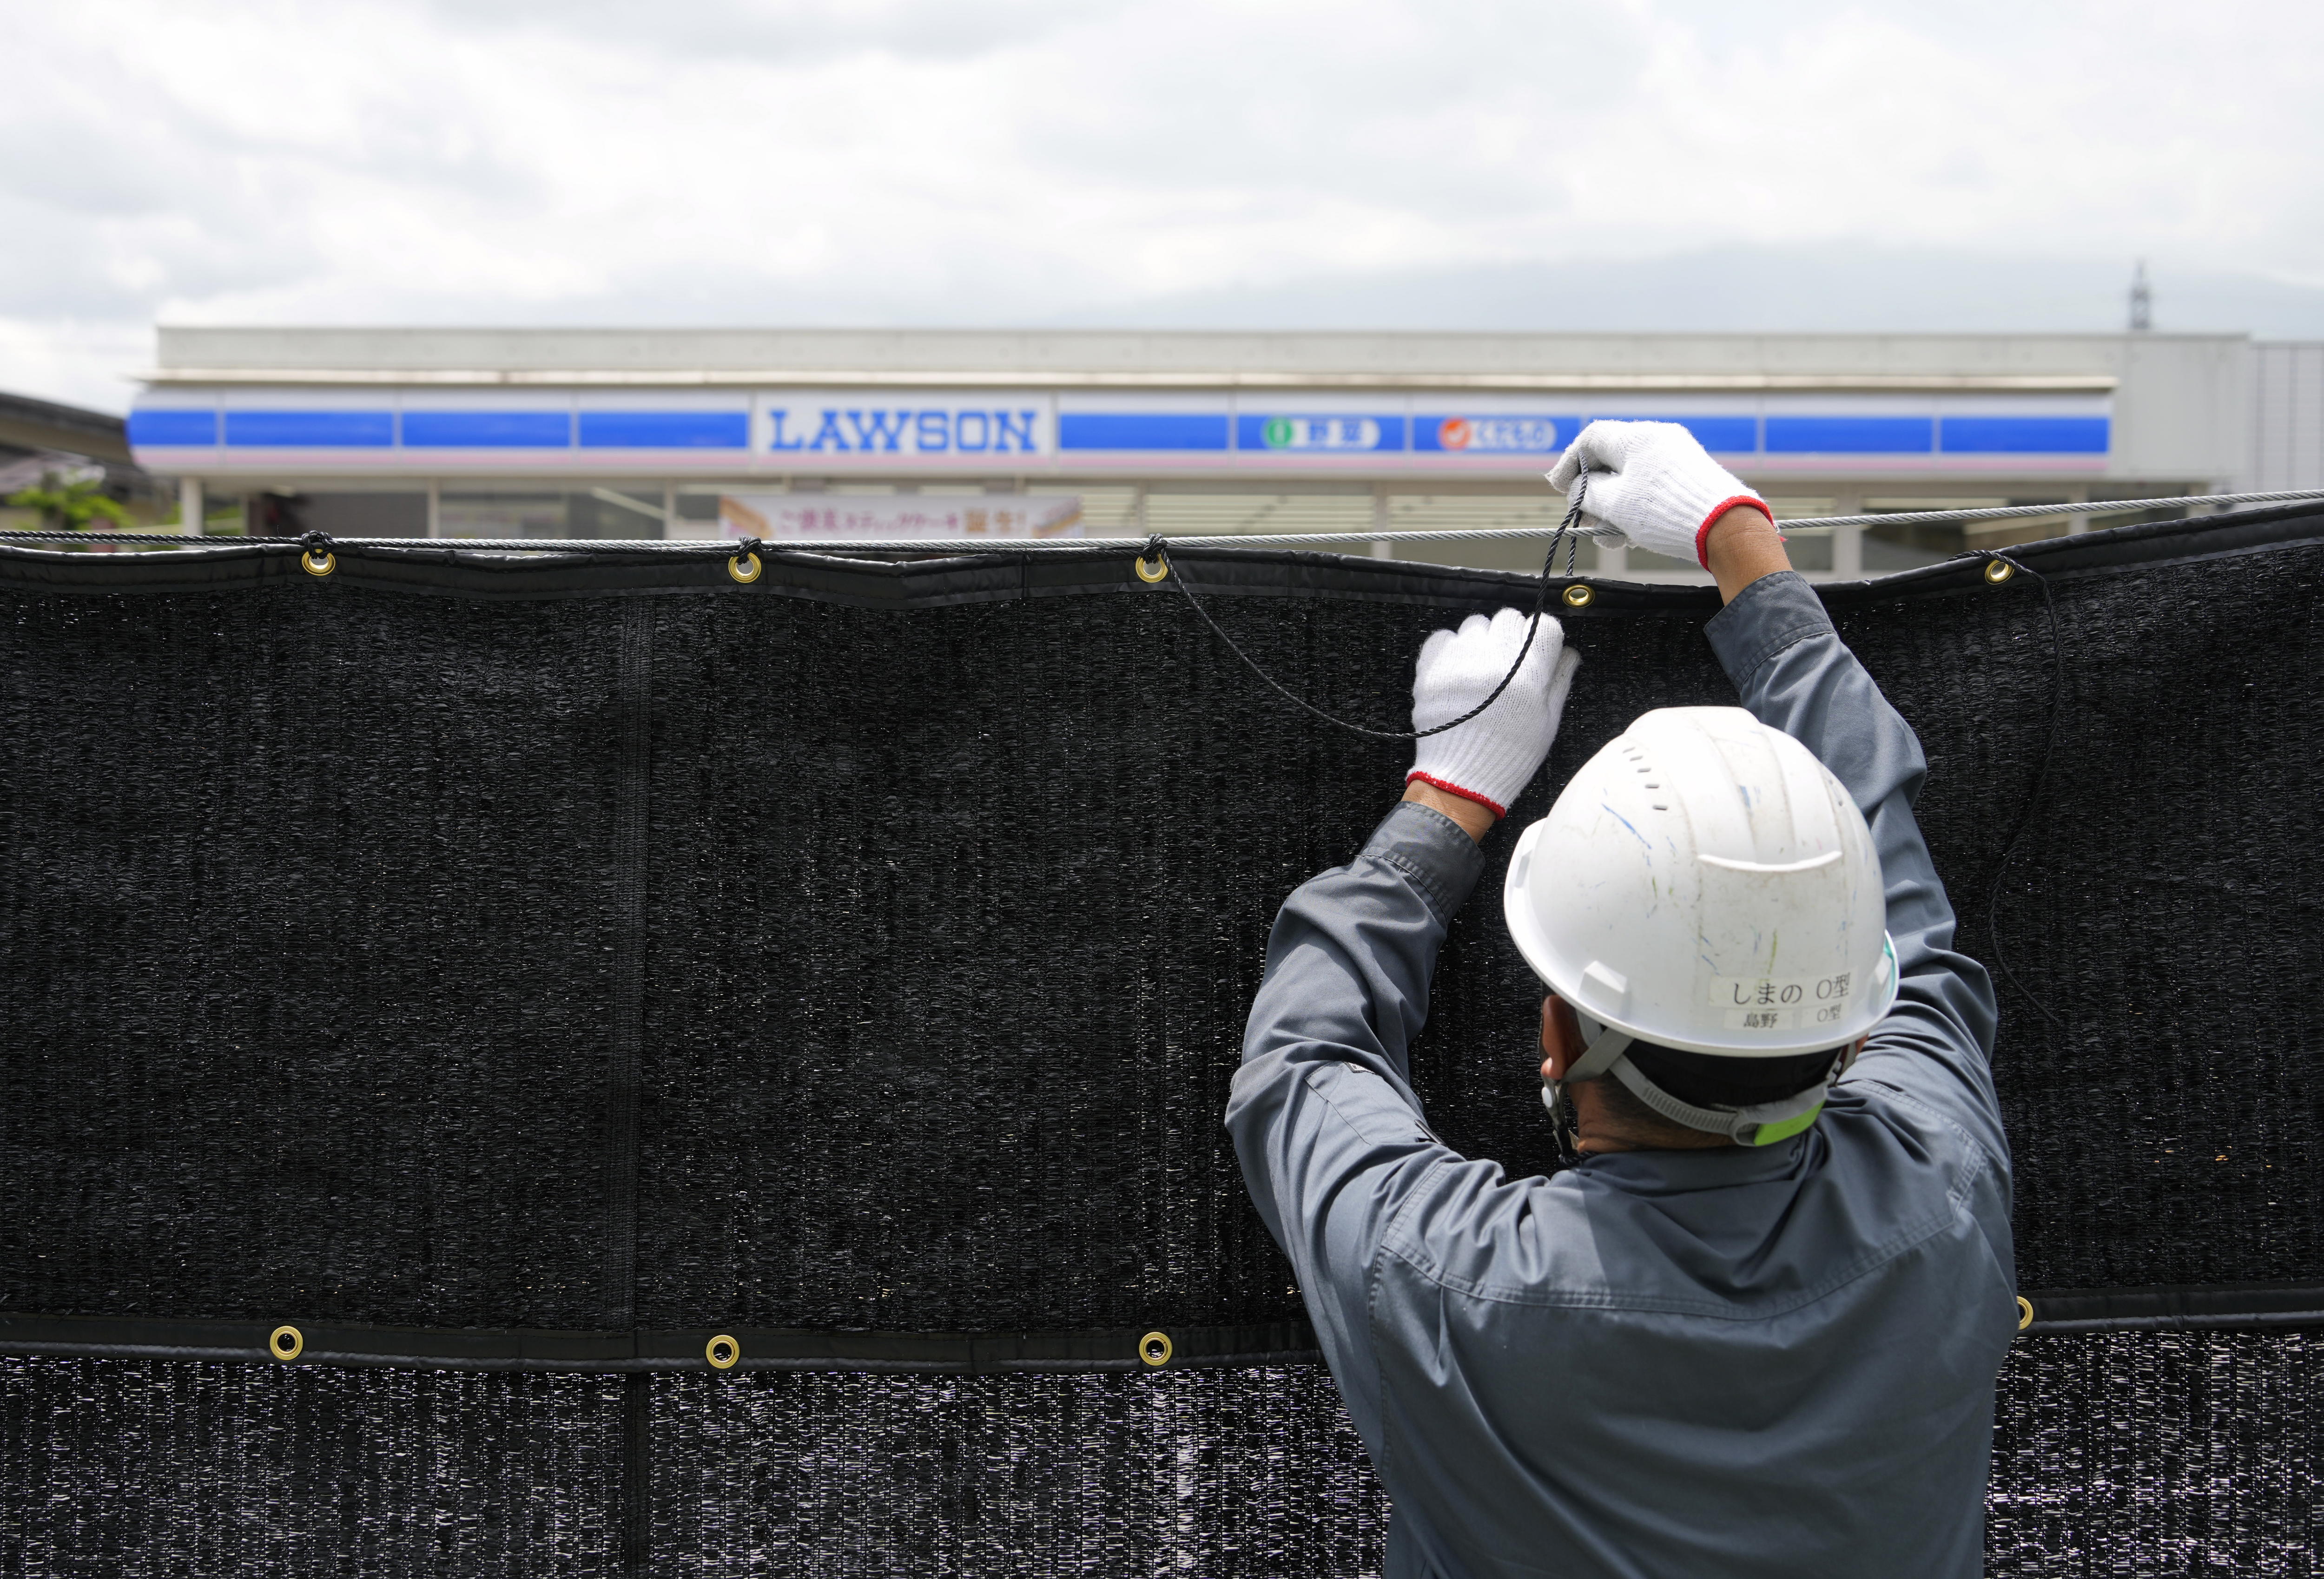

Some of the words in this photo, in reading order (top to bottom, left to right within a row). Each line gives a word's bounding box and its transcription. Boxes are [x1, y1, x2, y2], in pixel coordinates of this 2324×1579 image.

[770, 410, 1036, 452] LAWSON
[1734, 983, 1802, 1005] しまの
